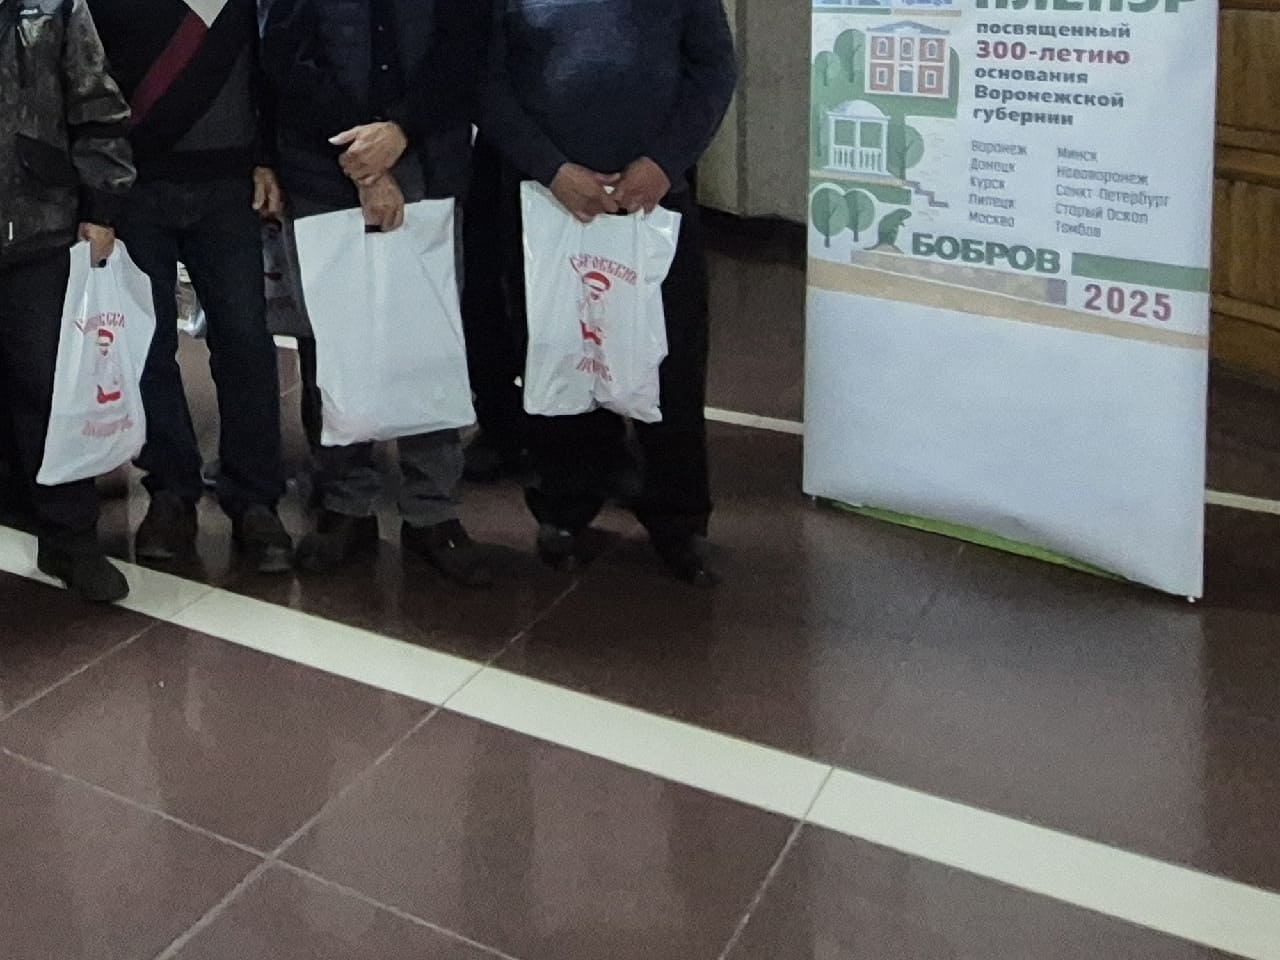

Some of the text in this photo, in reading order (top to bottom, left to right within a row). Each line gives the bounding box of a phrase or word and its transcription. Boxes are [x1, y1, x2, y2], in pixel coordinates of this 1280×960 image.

[976, 23, 1131, 38] посвященный
[976, 40, 1130, 65] 300-летию
[974, 67, 1089, 84] основания
[974, 84, 1125, 108] Воронежской
[972, 107, 1074, 126] губернии
[971, 140, 1027, 156] Воронеж
[1057, 146, 1098, 162] Минск
[970, 158, 1016, 173] Донецк
[970, 176, 1006, 191] Курск
[1056, 165, 1149, 186] Нововоронеж
[968, 193, 1016, 209] Липецк
[969, 211, 1015, 228] Москва
[1055, 203, 1149, 224] Старый Оскол
[1056, 220, 1102, 238] Тамбов
[910, 231, 1061, 275] БОБРОВ
[1084, 284, 1172, 322] 2025
